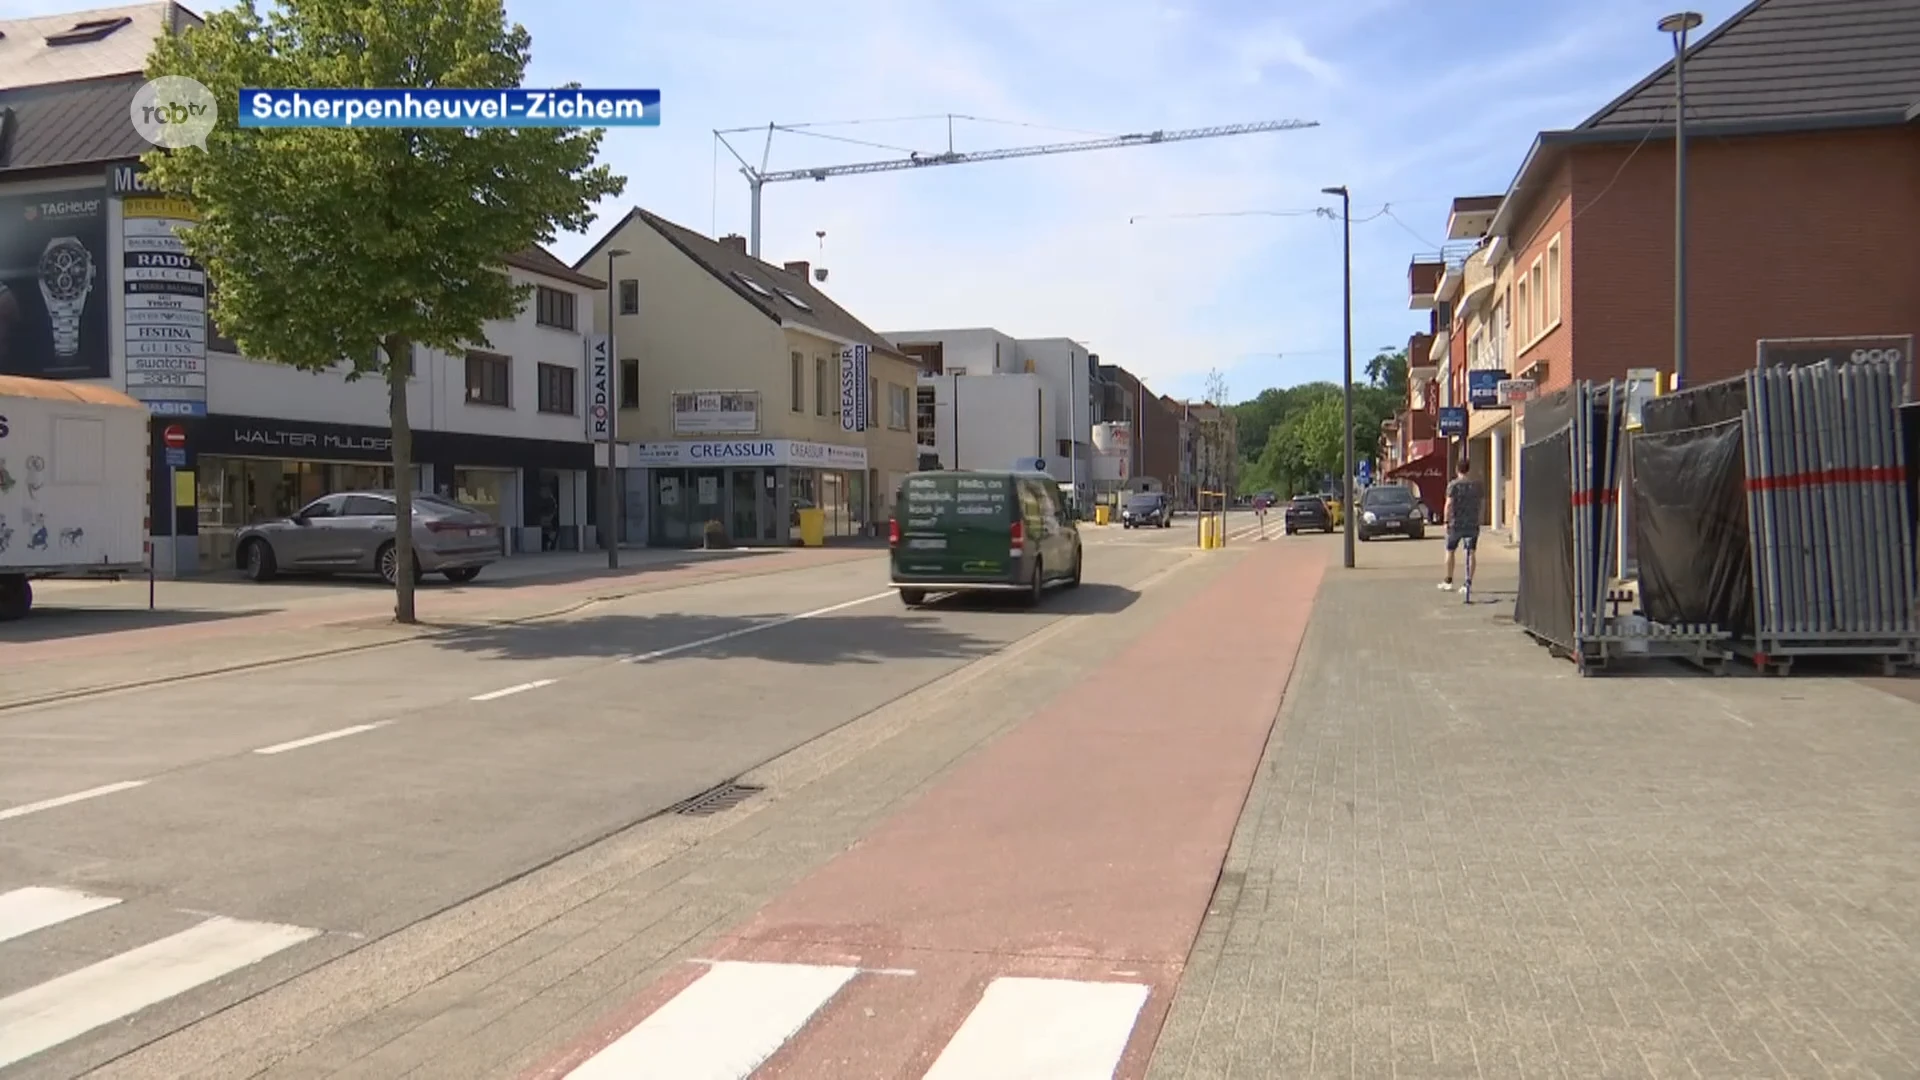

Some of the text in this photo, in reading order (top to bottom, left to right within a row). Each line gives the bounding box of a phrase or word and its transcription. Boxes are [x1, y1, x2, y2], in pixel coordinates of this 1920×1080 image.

[127, 199, 192, 213] BREITLIN
[138, 254, 191, 267] RADO
[136, 269, 192, 279] GUCCI
[147, 300, 182, 308] TISSOT
[139, 327, 191, 339] FESTINA
[140, 343, 192, 353] GUESS
[136, 358, 188, 369] swatch
[595, 341, 607, 432] RODANIA
[842, 349, 853, 430] CREASSUR
[150, 402, 193, 414] ASIO
[234, 428, 316, 447] WALTER
[690, 442, 775, 458] CREASSUR
[790, 442, 824, 458] CREASSUR
